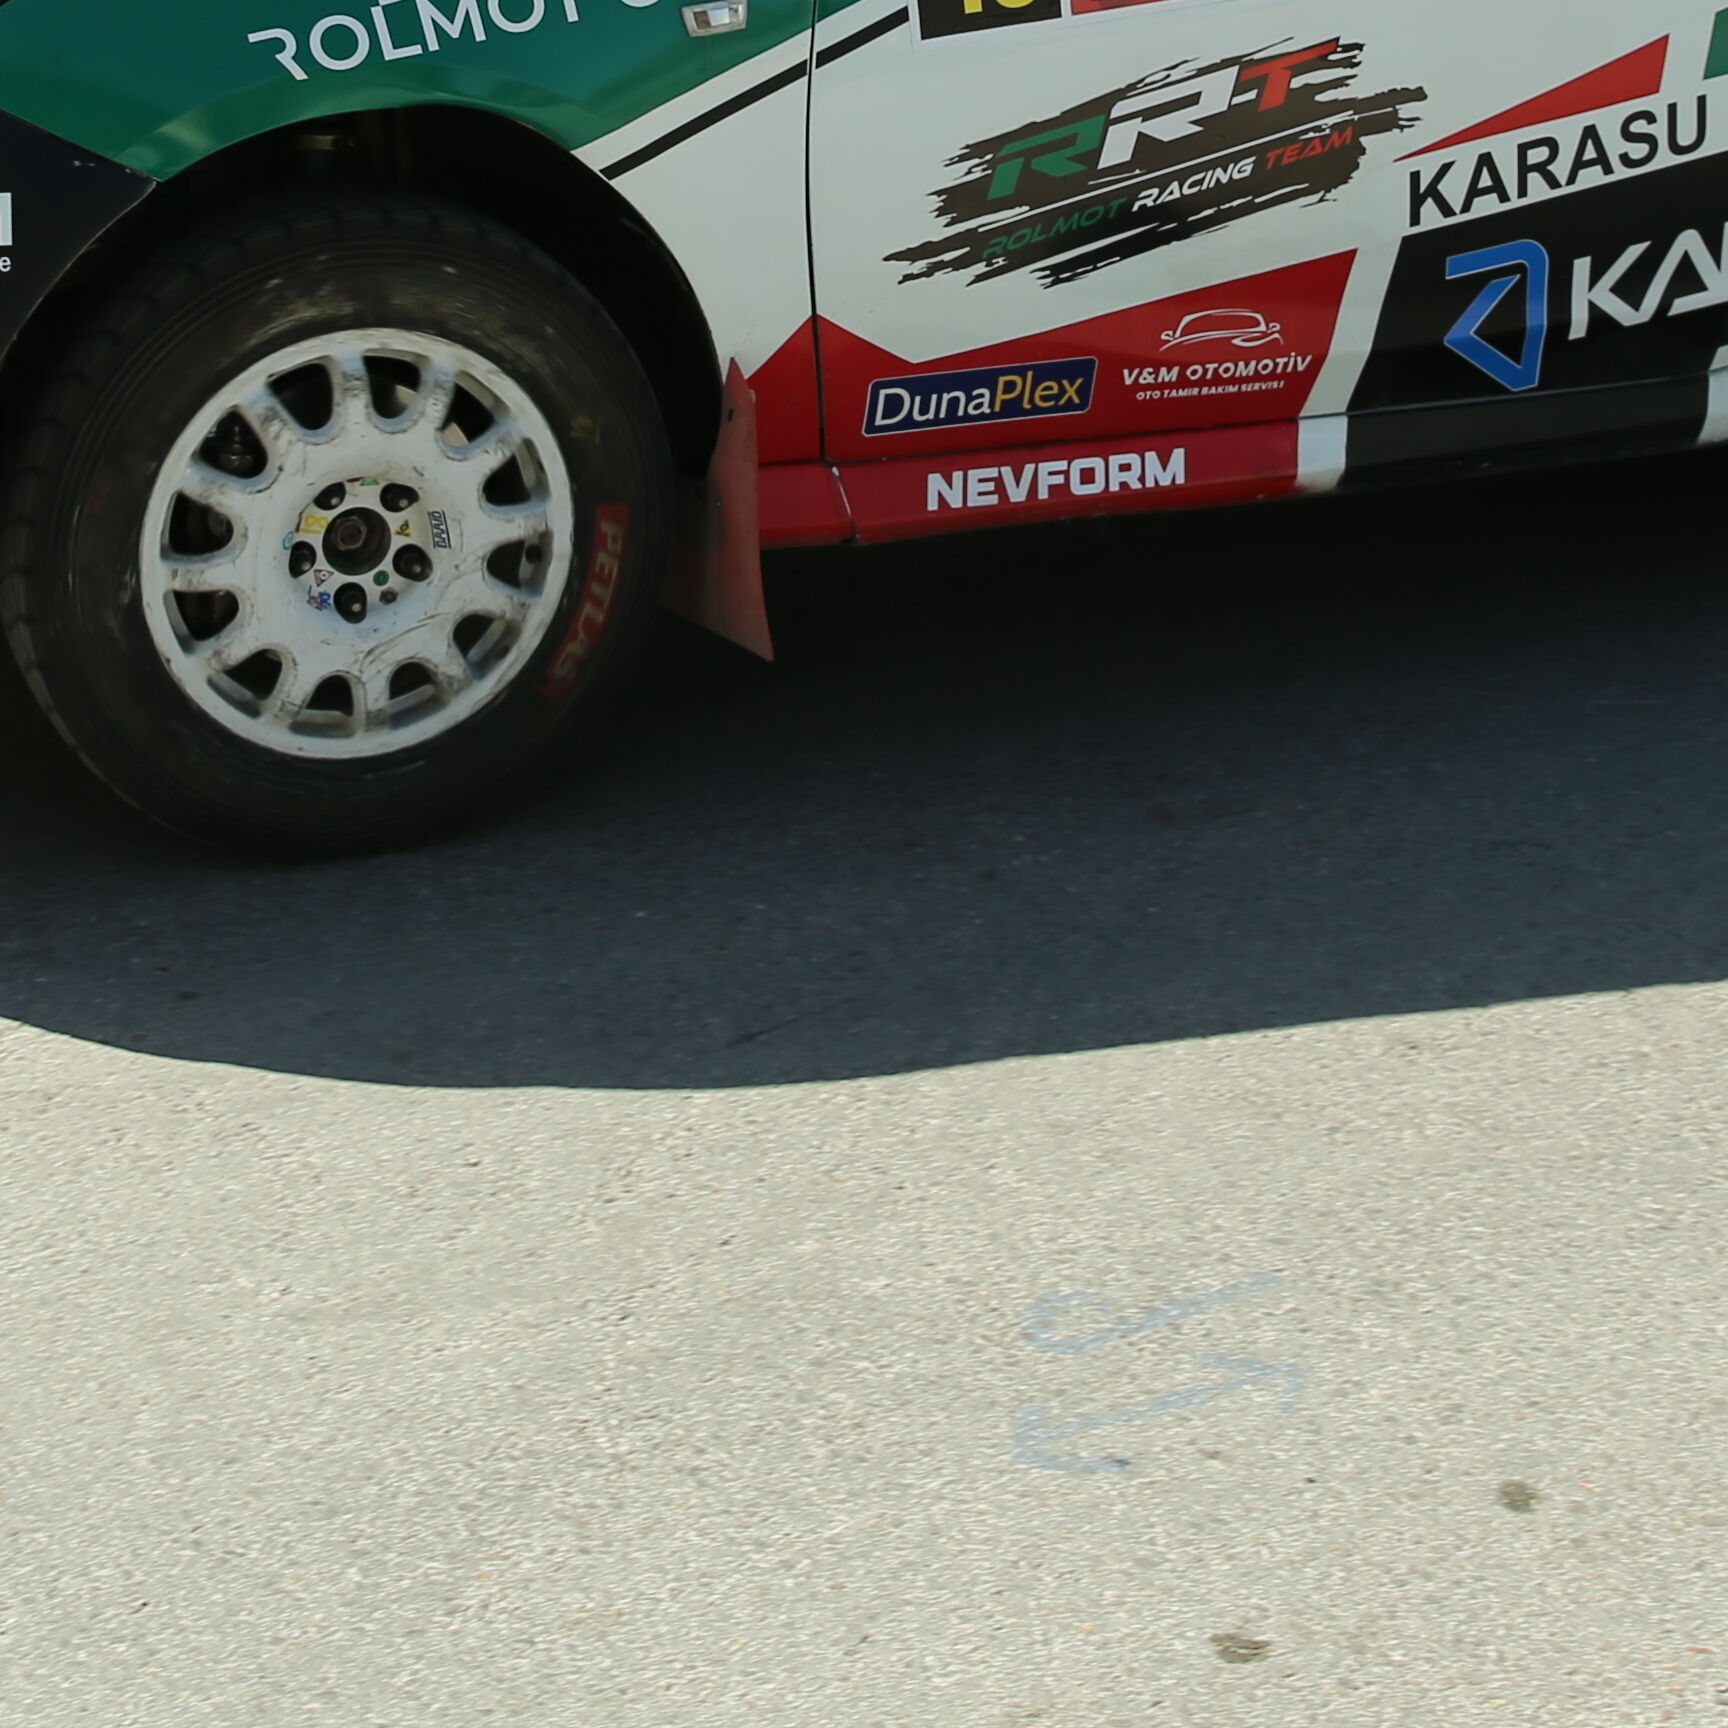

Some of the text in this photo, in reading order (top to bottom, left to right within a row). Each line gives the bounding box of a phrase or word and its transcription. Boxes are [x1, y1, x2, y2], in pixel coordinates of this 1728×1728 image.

[986, 36, 1341, 201] RRT
[981, 126, 1354, 259] ROLMOT RACING TEAM
[1407, 93, 1708, 229] KARASU
[874, 371, 1085, 427] DunaPlex
[1122, 351, 1314, 386] V&M OTOMOTİV
[1135, 390, 1161, 401] OTO
[926, 447, 1187, 511] NEVFORM
